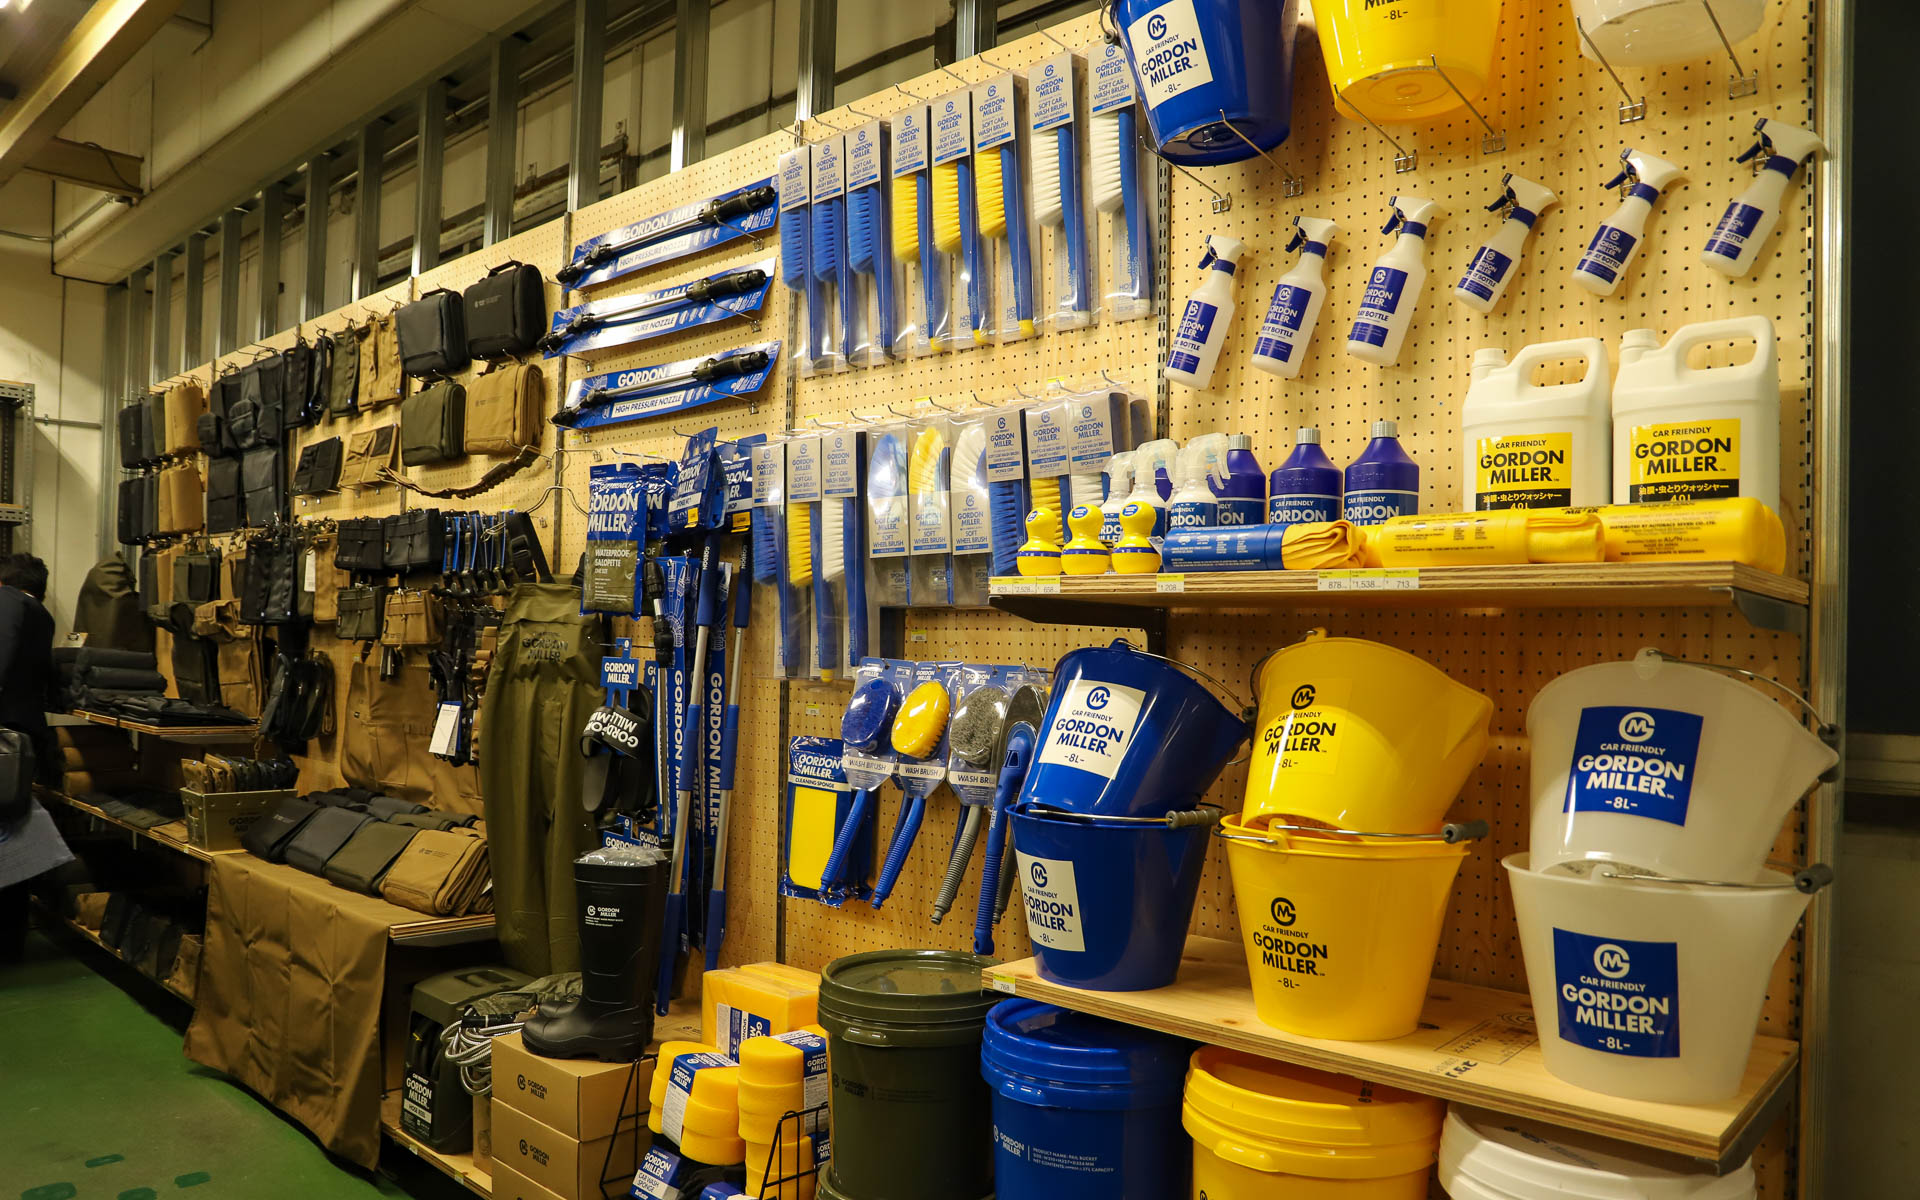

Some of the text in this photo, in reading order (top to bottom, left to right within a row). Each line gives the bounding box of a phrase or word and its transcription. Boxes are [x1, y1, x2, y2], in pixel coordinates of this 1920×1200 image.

[1146, 34, 1179, 55] CAR FRIENDLY
[1142, 38, 1197, 75] GORDON
[1096, 58, 1125, 73] GORDON
[1100, 67, 1122, 79] MILLER
[1151, 57, 1192, 87] MILLER
[1036, 77, 1063, 92] GORDON
[1040, 85, 1059, 97] MILLER
[1094, 84, 1129, 100] WASH BRUSH
[1098, 79, 1124, 92] SOFT CAR
[979, 97, 1005, 112] GORDON
[983, 105, 1001, 117] MILLER
[1034, 102, 1067, 117] WASH BRUSH
[1039, 101, 1050, 110] SOFT
[937, 113, 961, 127] GORDON
[897, 128, 919, 140] GORDON
[851, 142, 872, 155] GORDON
[623, 216, 668, 240] GORDON
[620, 246, 662, 266] HIGH PRESSURE
[650, 317, 675, 330] NOZZLE
[1366, 311, 1389, 321] BOTTLE
[1271, 327, 1293, 337] BOTTLE
[618, 369, 666, 387] GORDON
[615, 395, 682, 412] HIGH PRESSURE NOZZLE
[1033, 427, 1060, 437] GORDON
[1074, 422, 1103, 432] GORDON
[1078, 430, 1100, 439] MILLER
[1672, 427, 1711, 435] FRIENDLY
[991, 433, 1014, 441] GORDON
[994, 440, 1012, 448] MILLER
[1038, 434, 1057, 442] MILLER
[1636, 438, 1731, 458] GORDON
[1481, 450, 1564, 469] GORDON
[1647, 456, 1718, 476] MILLER
[1491, 467, 1552, 484] MILLER
[590, 492, 639, 512] GORDON
[588, 514, 627, 532] MILLER
[1270, 509, 1326, 523] GORDON
[595, 559, 621, 567] SALOPETTE
[605, 663, 634, 673] GORDON
[607, 673, 630, 684] MILLER
[675, 670, 683, 761] GORDON
[709, 672, 722, 761] GORDON
[1084, 711, 1113, 722] FRIENDLY
[1056, 719, 1124, 743] GORDON
[1056, 733, 1106, 756] MILLER
[1267, 738, 1320, 756] MLLER
[1600, 743, 1666, 755] CAR FRIENDLY
[799, 754, 841, 769] GORDON
[849, 759, 886, 770] WASH BRUSH
[1578, 755, 1685, 781] GORDON
[800, 765, 832, 779] MILLER
[920, 768, 938, 776] BRUSH
[958, 774, 978, 783] WASH
[1586, 772, 1666, 797] MILLER
[1035, 890, 1057, 898] FRIENDLY
[1024, 893, 1073, 917] GORDON
[1030, 910, 1066, 932] MILLER
[1277, 928, 1308, 938] FRIENDLY
[1253, 932, 1328, 959] GORDON
[1263, 951, 1318, 976] MILLER
[1580, 976, 1646, 992] CAR FRIENDLY
[1562, 984, 1669, 1015] GORDON
[1576, 1006, 1656, 1034] MILLER
[674, 1068, 691, 1083] GORDON
[407, 1078, 432, 1099] GORDON
[528, 1080, 547, 1094] GORDON
[531, 1088, 545, 1099] MILLER
[409, 1089, 428, 1108] MILLER
[1000, 1133, 1024, 1151] GORDON
[1003, 1141, 1021, 1157] MILLER
[530, 1145, 549, 1160] GORDON
[645, 1153, 671, 1171] GORDON
[643, 1162, 663, 1178] MILLER
[637, 1180, 654, 1192] SPONGE
[647, 1177, 659, 1187] WASH
